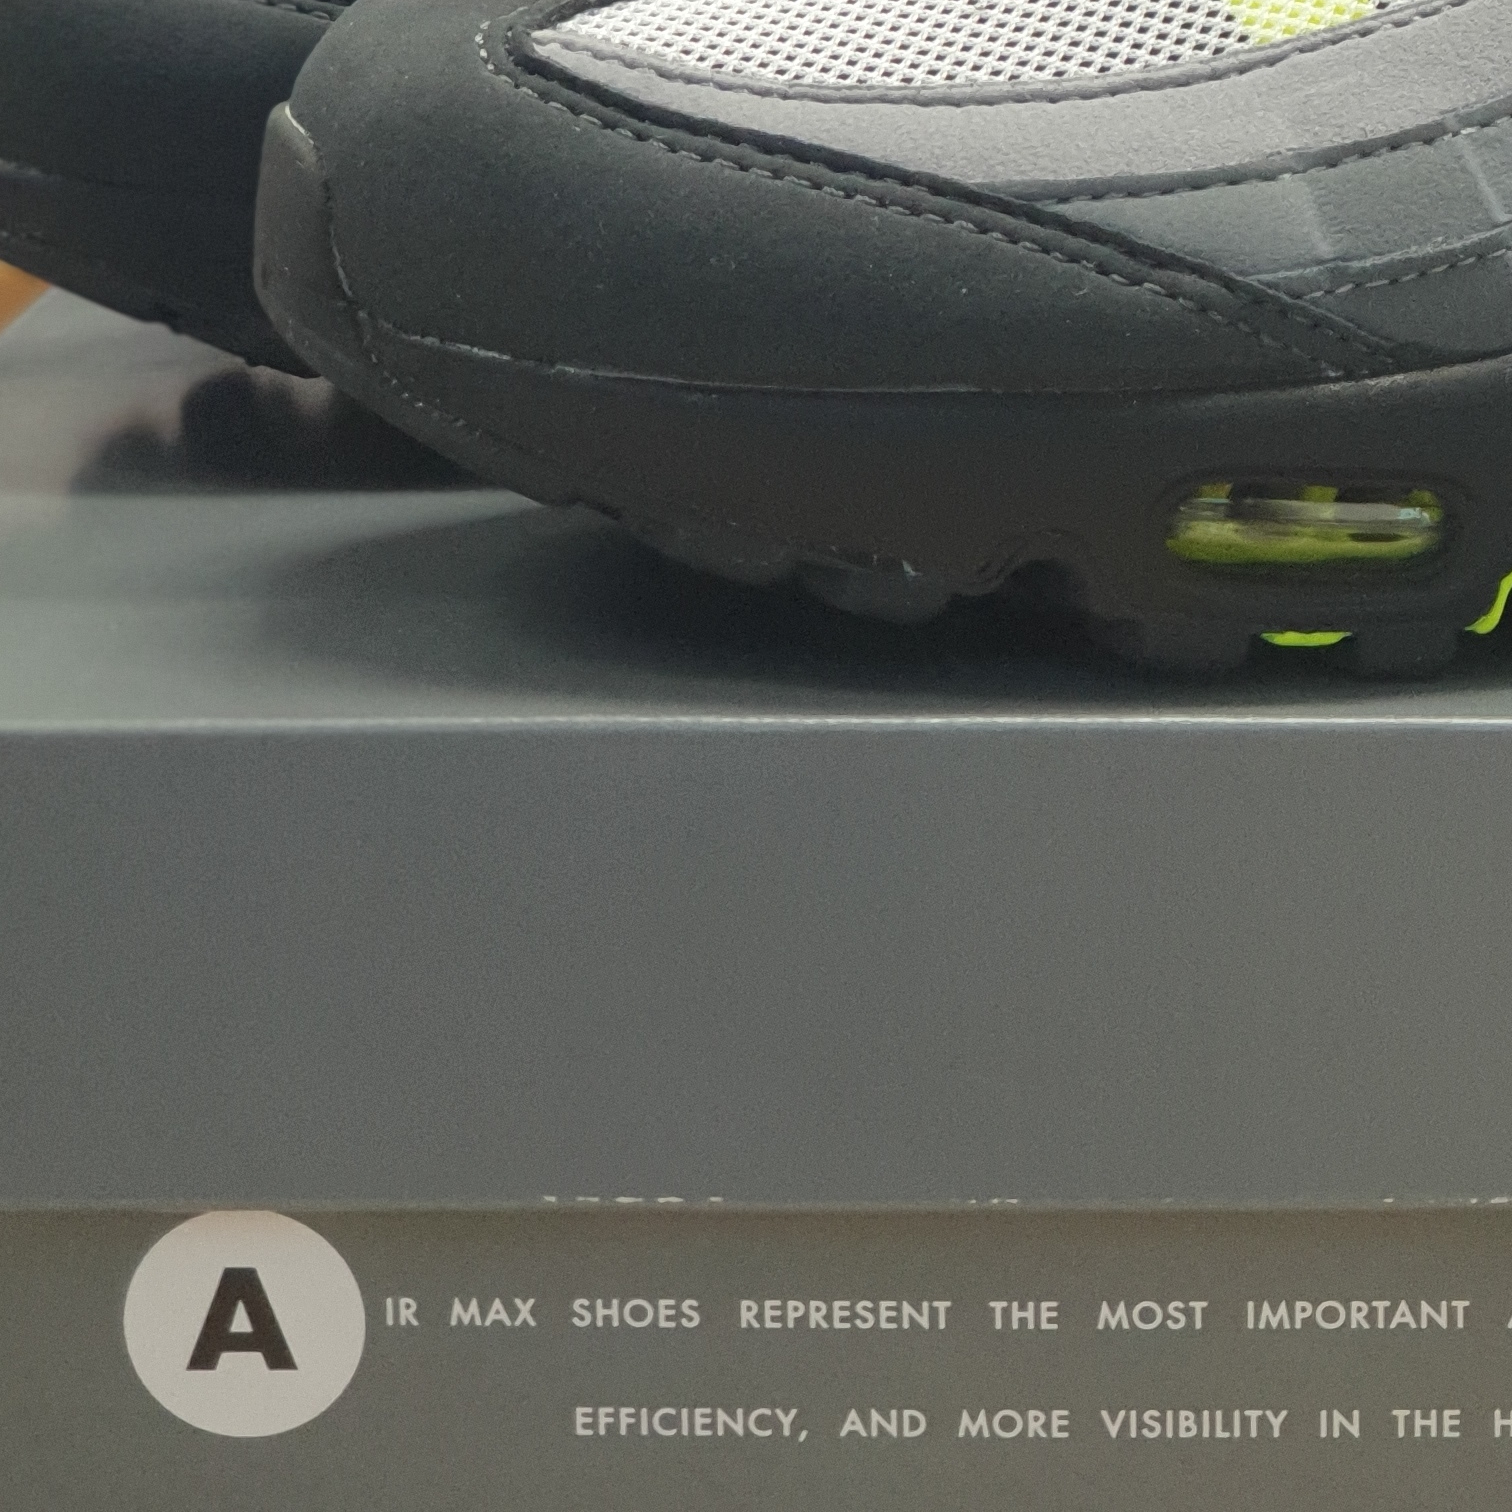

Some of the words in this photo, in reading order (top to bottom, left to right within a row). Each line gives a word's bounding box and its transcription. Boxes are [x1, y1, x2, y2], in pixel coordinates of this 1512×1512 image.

[186, 1267, 298, 1371] A
[385, 1296, 419, 1327] IR
[450, 1297, 537, 1327] MAX
[571, 1297, 701, 1329] SHOES
[739, 1299, 952, 1330] REPRESENT
[988, 1300, 1059, 1330] THE
[1096, 1300, 1208, 1330] MOST
[1246, 1299, 1470, 1330] IMPORTANT
[575, 1406, 808, 1442] EFFICIENCY,
[839, 1408, 927, 1438] AND
[958, 1409, 1069, 1439] MORE
[1100, 1409, 1288, 1439] VISIBILITY
[1319, 1409, 1360, 1438] IN
[1391, 1409, 1461, 1438] THE
